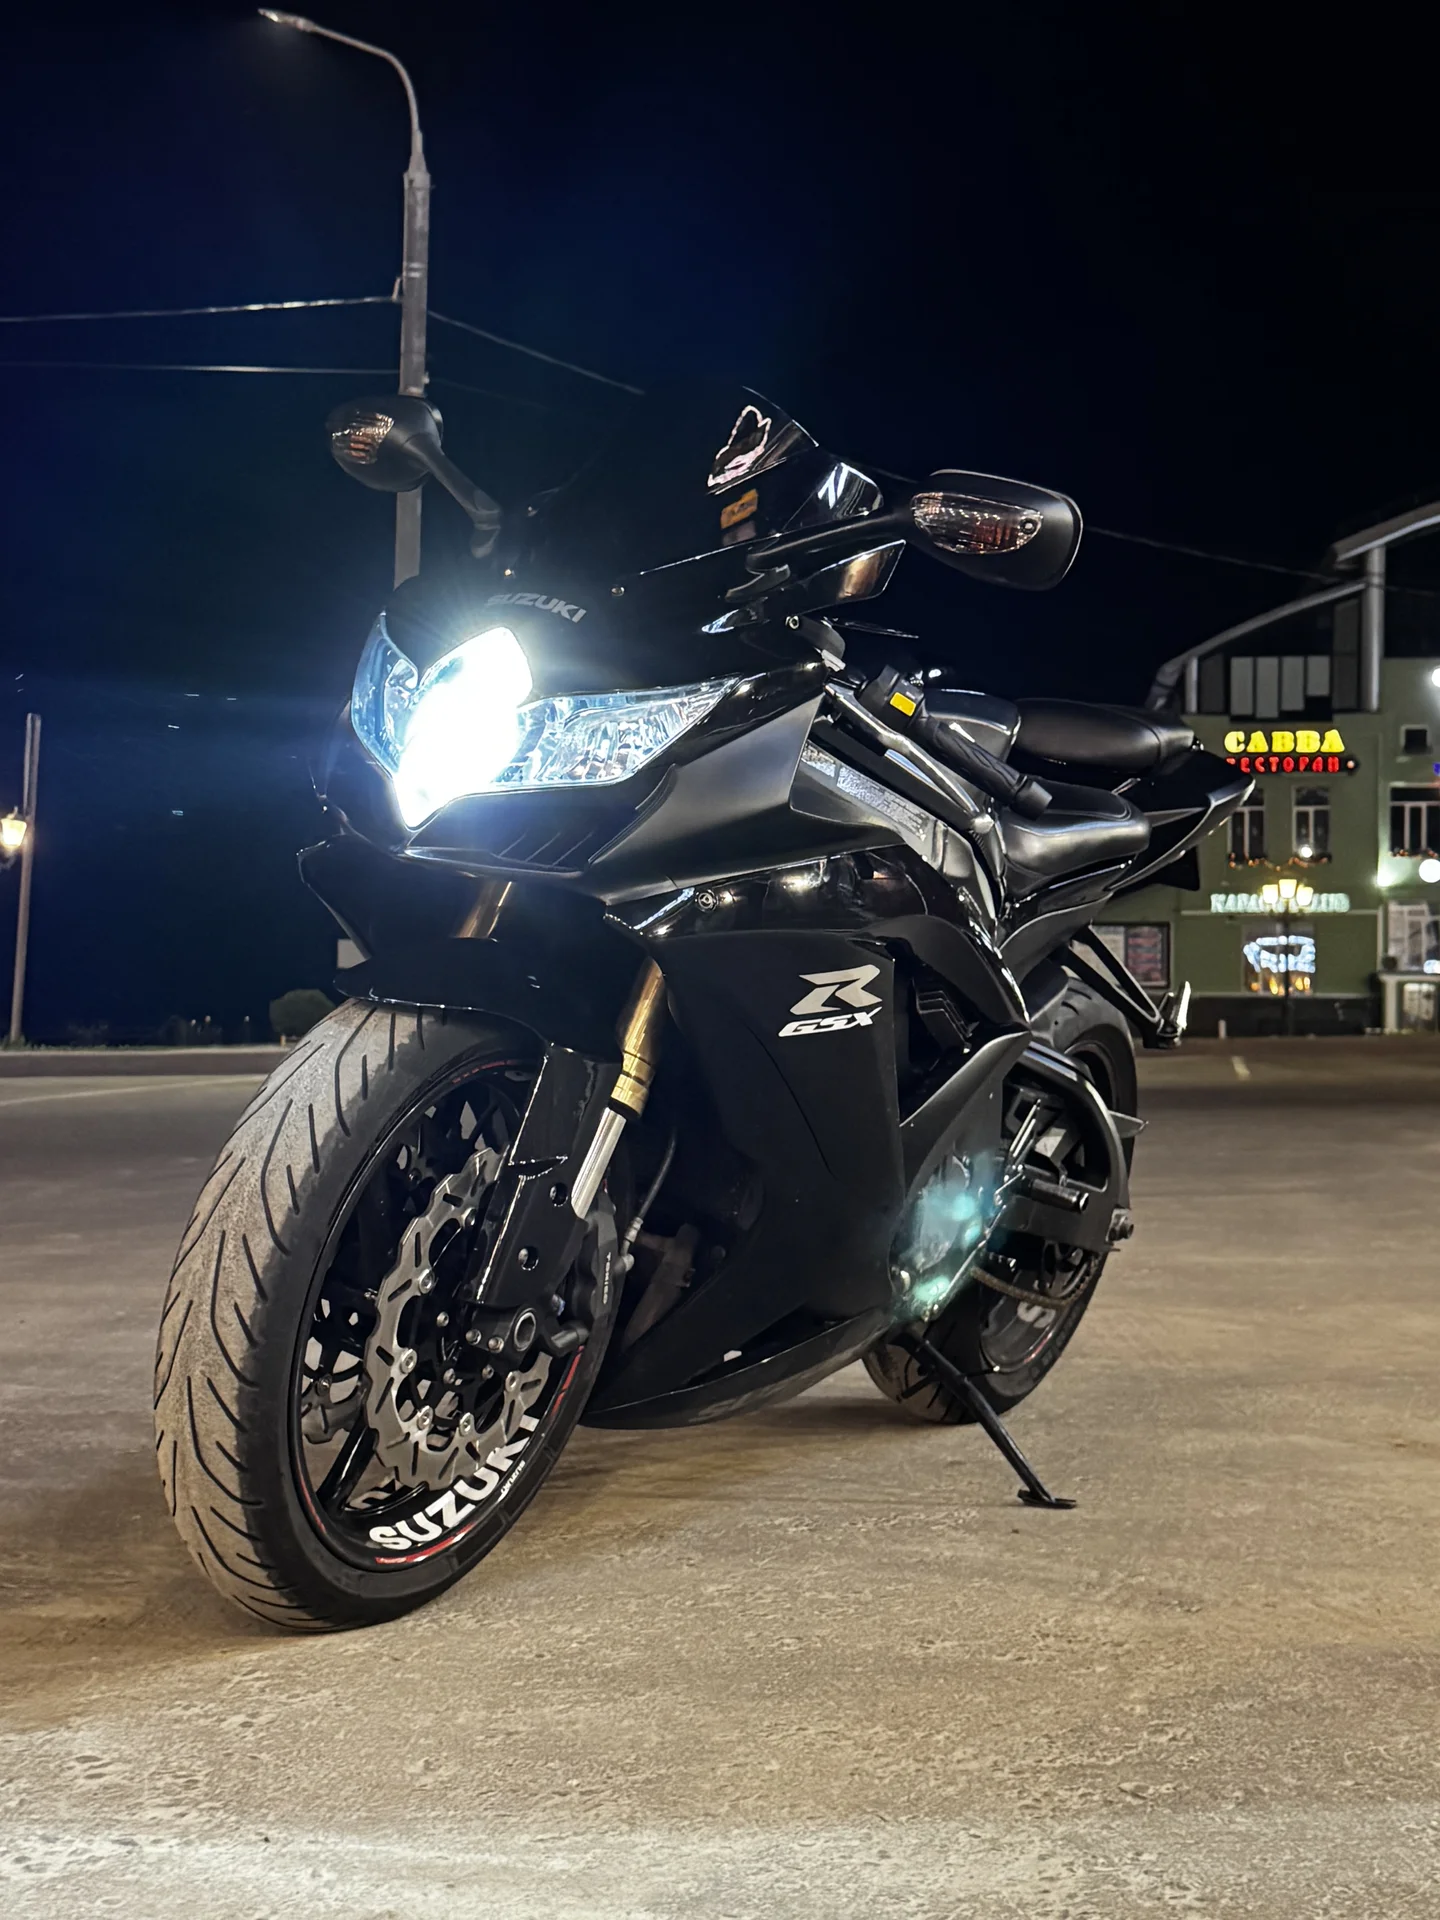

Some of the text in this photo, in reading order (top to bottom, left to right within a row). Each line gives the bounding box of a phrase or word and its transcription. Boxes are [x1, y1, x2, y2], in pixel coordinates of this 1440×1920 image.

[485, 592, 587, 623] SUZUKI
[1224, 729, 1345, 753] САВВА
[778, 1006, 883, 1037] GSX
[369, 1414, 540, 1550] SUZUKI
